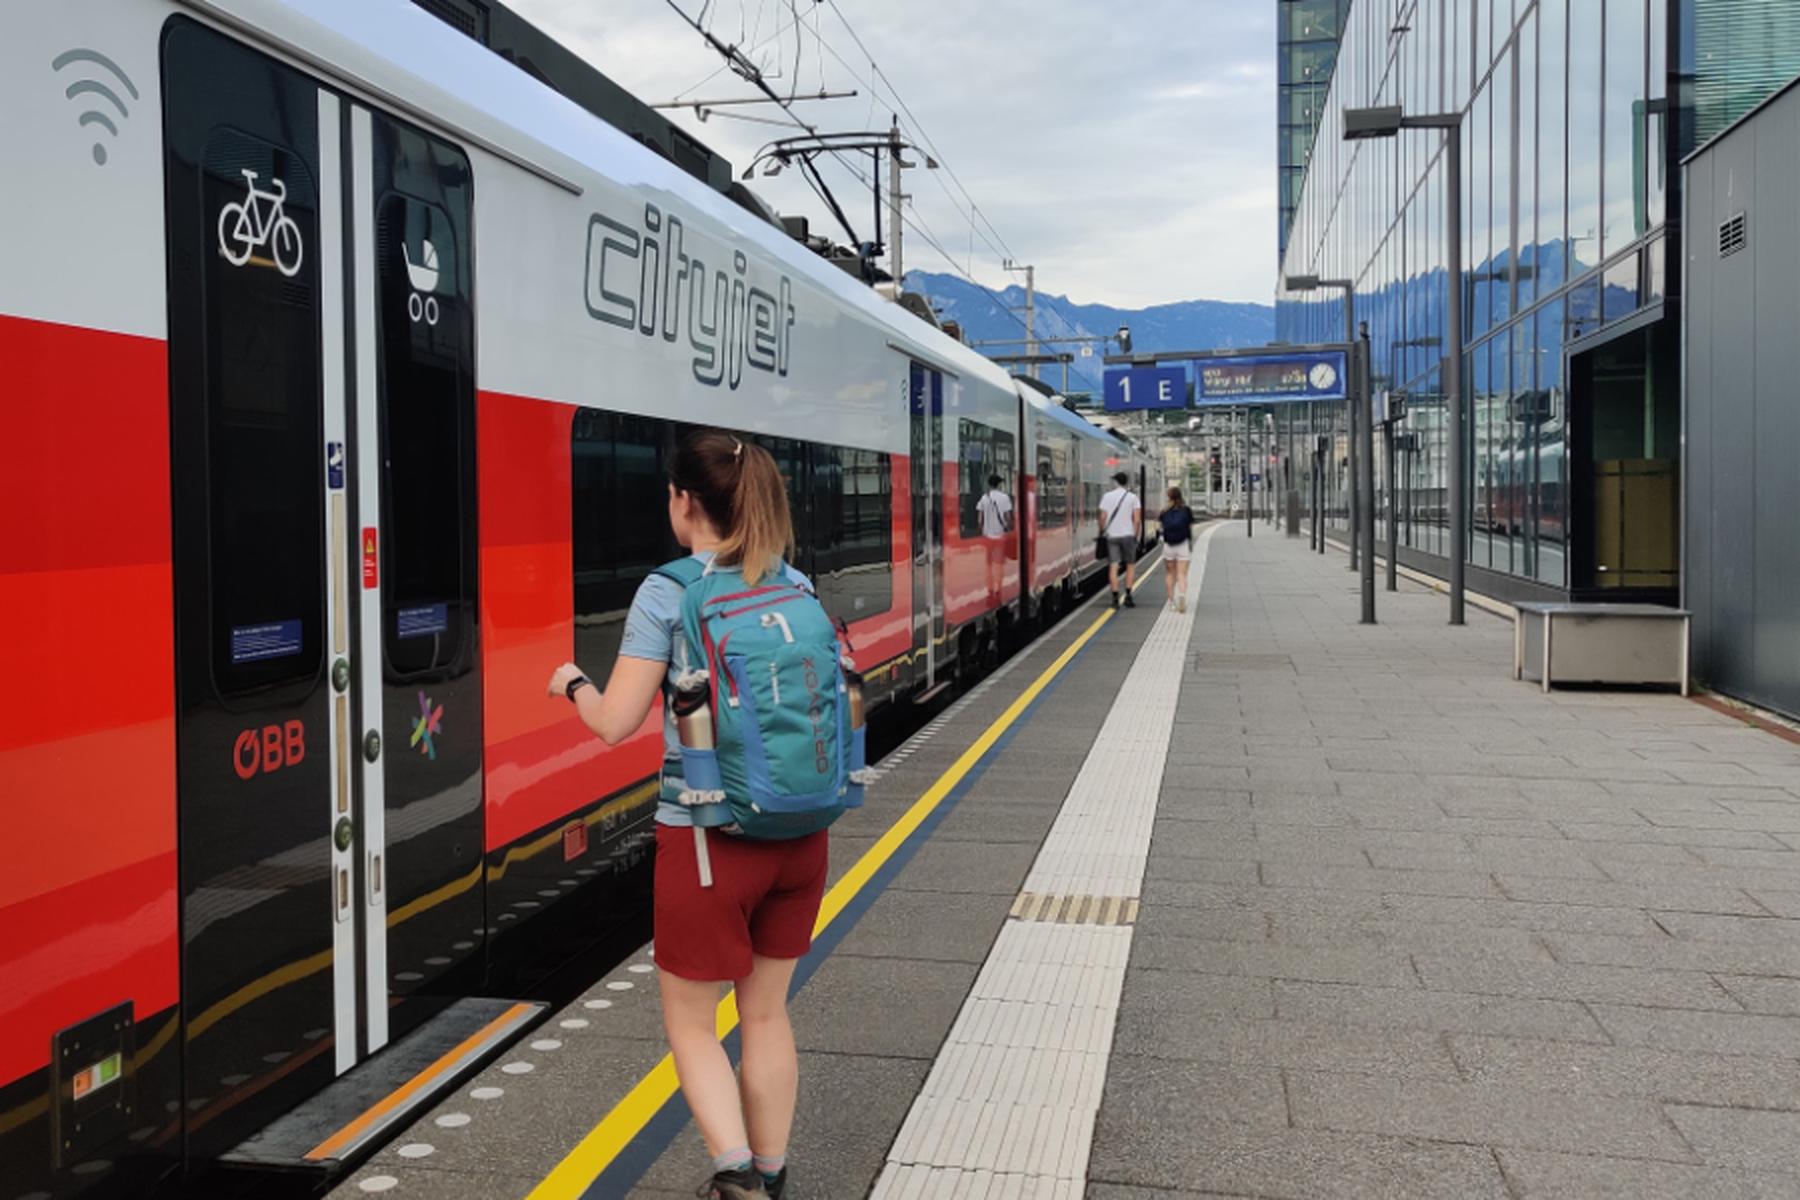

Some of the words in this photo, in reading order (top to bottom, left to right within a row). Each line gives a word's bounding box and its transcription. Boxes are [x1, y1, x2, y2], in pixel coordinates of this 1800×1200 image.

[584, 202, 795, 390] cityjet
[1118, 376, 1131, 402] 1
[1158, 380, 1172, 400] E
